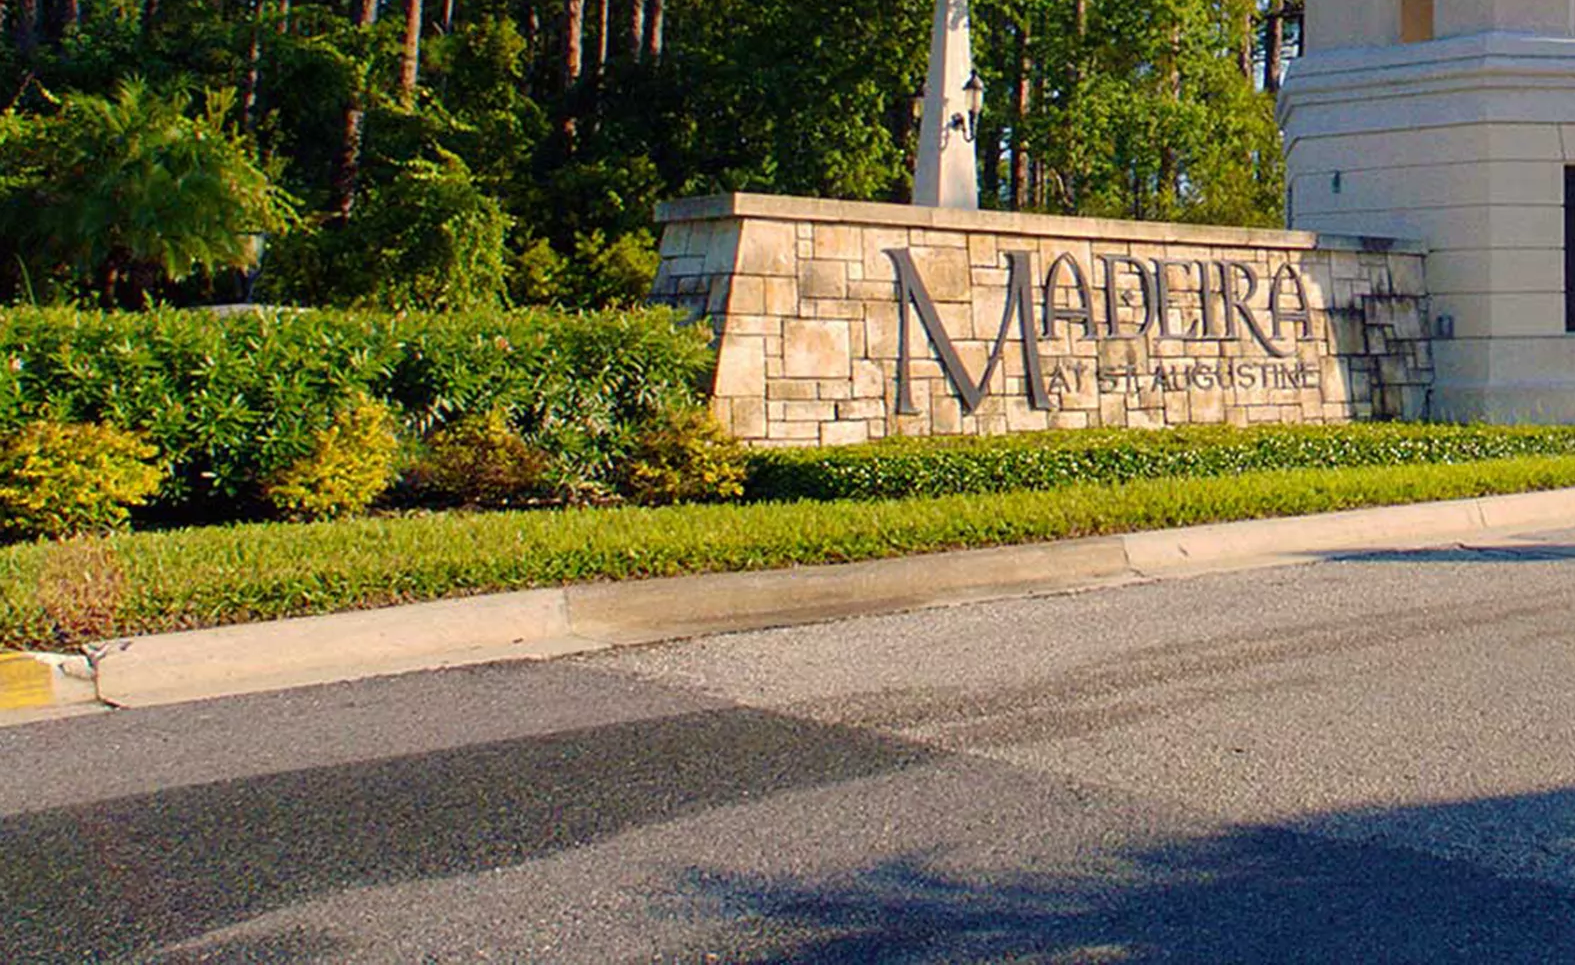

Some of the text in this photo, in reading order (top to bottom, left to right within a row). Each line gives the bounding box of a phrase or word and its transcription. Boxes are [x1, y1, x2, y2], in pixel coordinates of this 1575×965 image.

[881, 248, 1314, 414] MADEIRA
[1048, 362, 1086, 394] AT
[1150, 362, 1318, 393] AUGUSTINE
